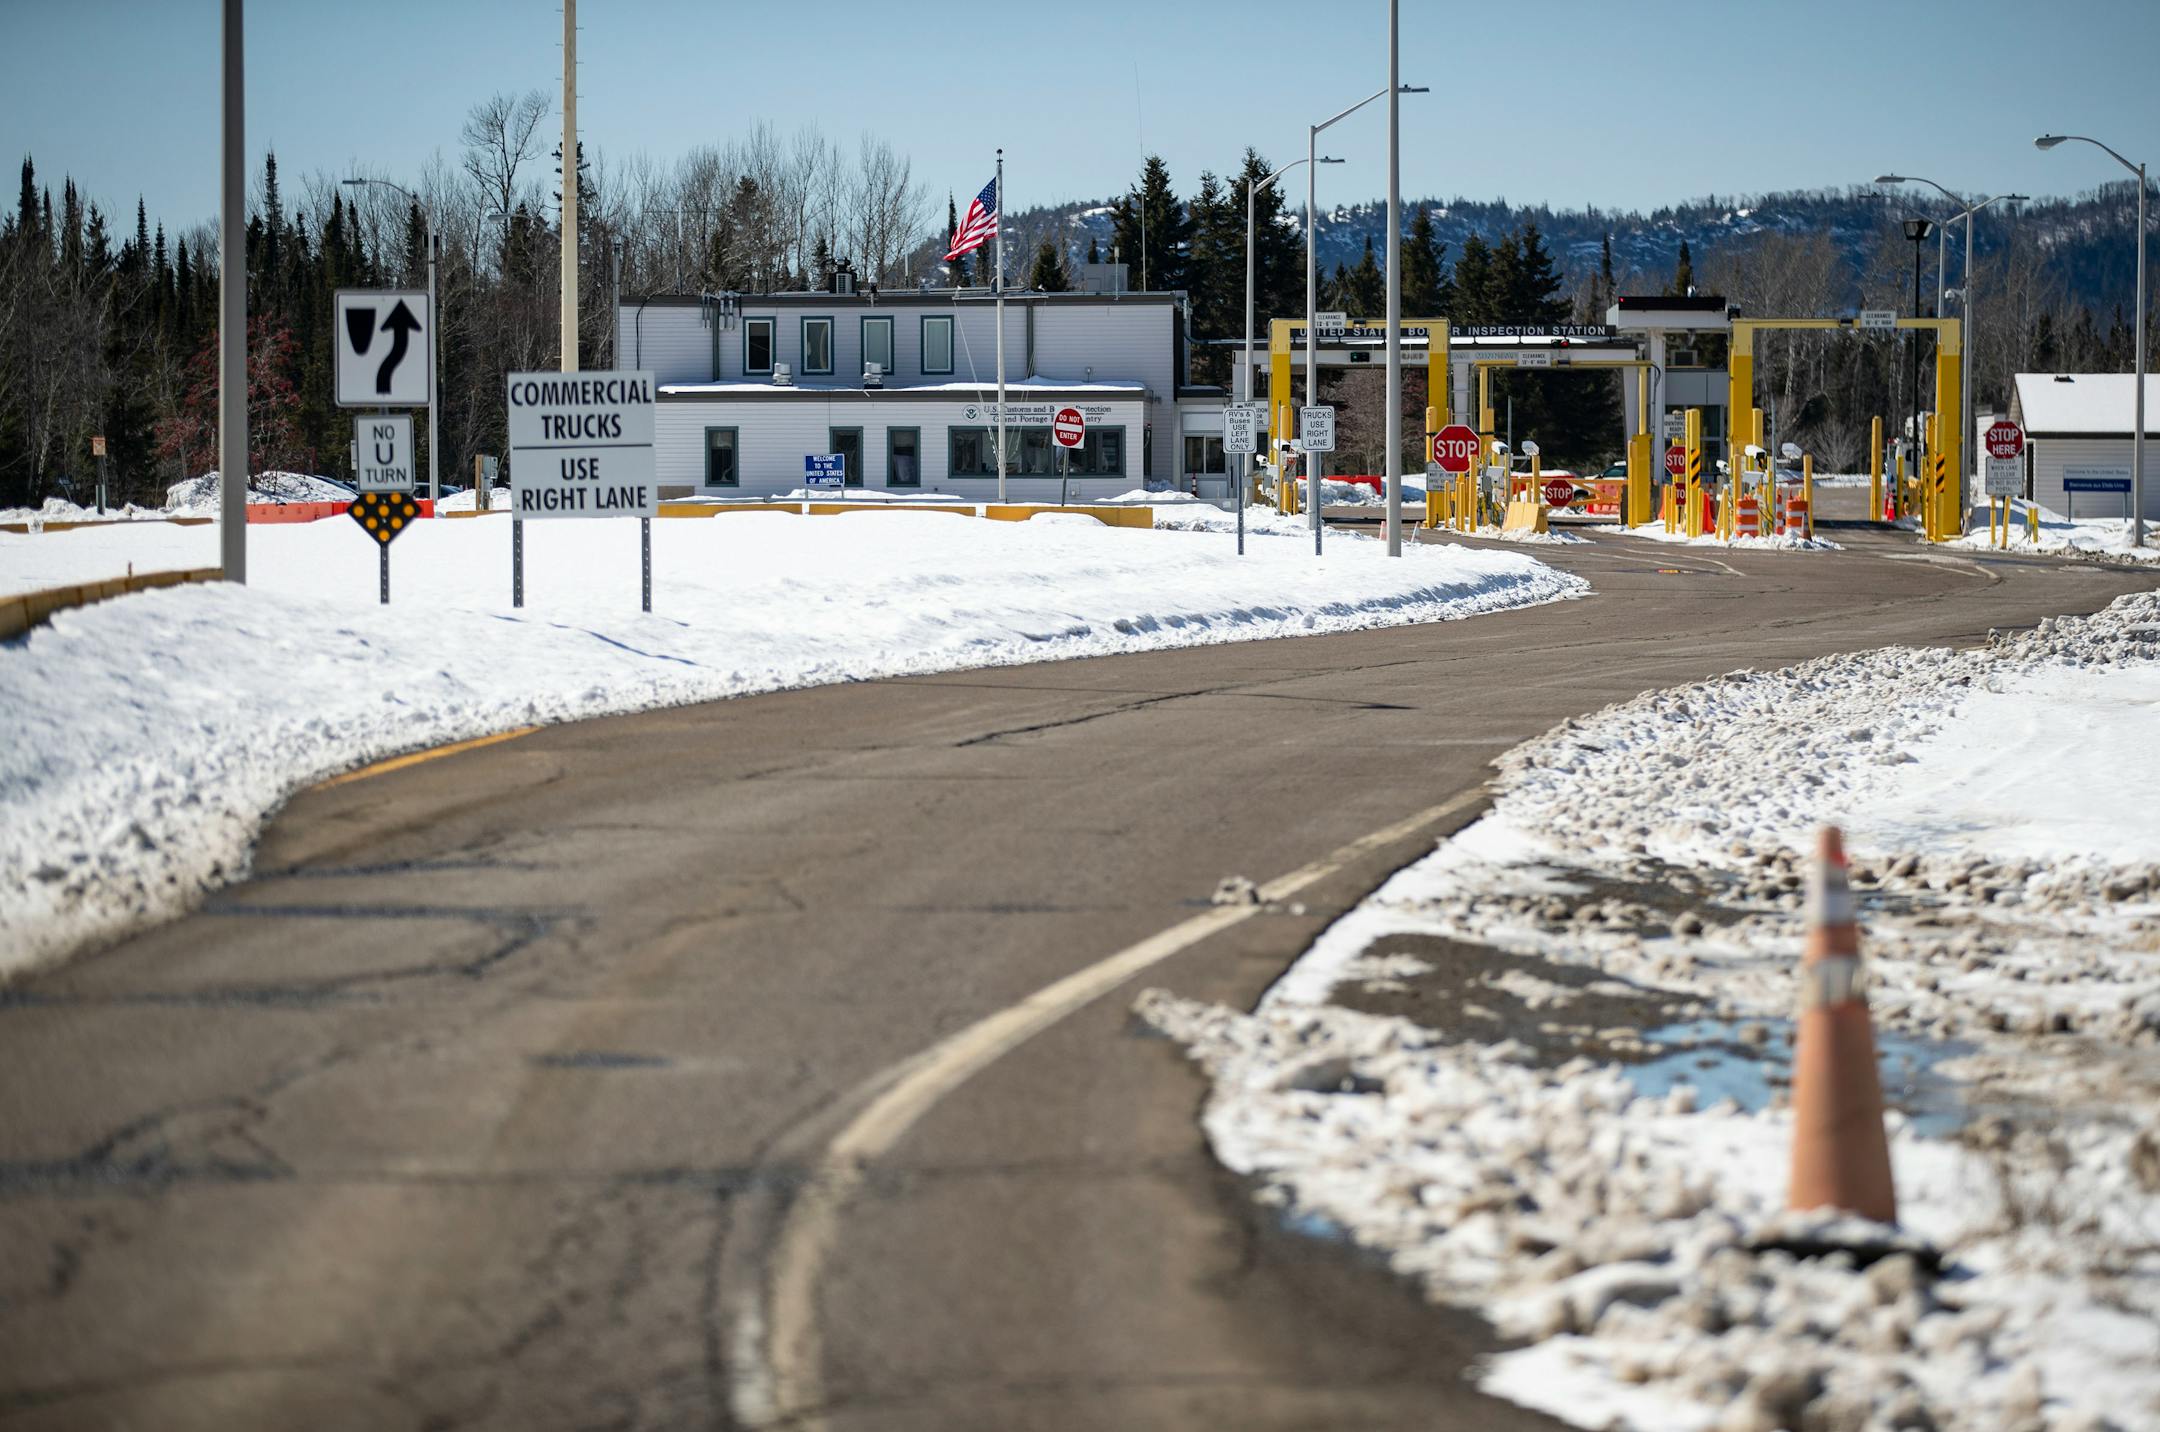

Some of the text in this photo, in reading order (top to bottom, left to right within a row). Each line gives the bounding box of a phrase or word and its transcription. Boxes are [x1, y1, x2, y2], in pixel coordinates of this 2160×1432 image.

[1299, 328, 1346, 336] UITED
[1467, 326, 1545, 336] INSPECTION
[1552, 326, 1606, 336] STATION
[511, 380, 652, 407] COMMERCIAL
[1033, 405, 1046, 413] and
[1020, 415, 1048, 423] Portage
[1058, 413, 1067, 421] DO
[1068, 415, 1081, 423] NOT
[373, 425, 395, 440] NO
[541, 413, 622, 440] TRUCKS
[1059, 432, 1078, 441] ENTER
[1989, 428, 2019, 442] STOP
[375, 442, 394, 465] U
[1436, 440, 1478, 458] STOP
[1992, 444, 2016, 455] HERE
[1666, 454, 1685, 466] STO
[365, 468, 407, 483] TURN
[561, 457, 600, 481] USE
[522, 486, 647, 511] RIGHT LANE
[1546, 489, 1572, 500] STOP
